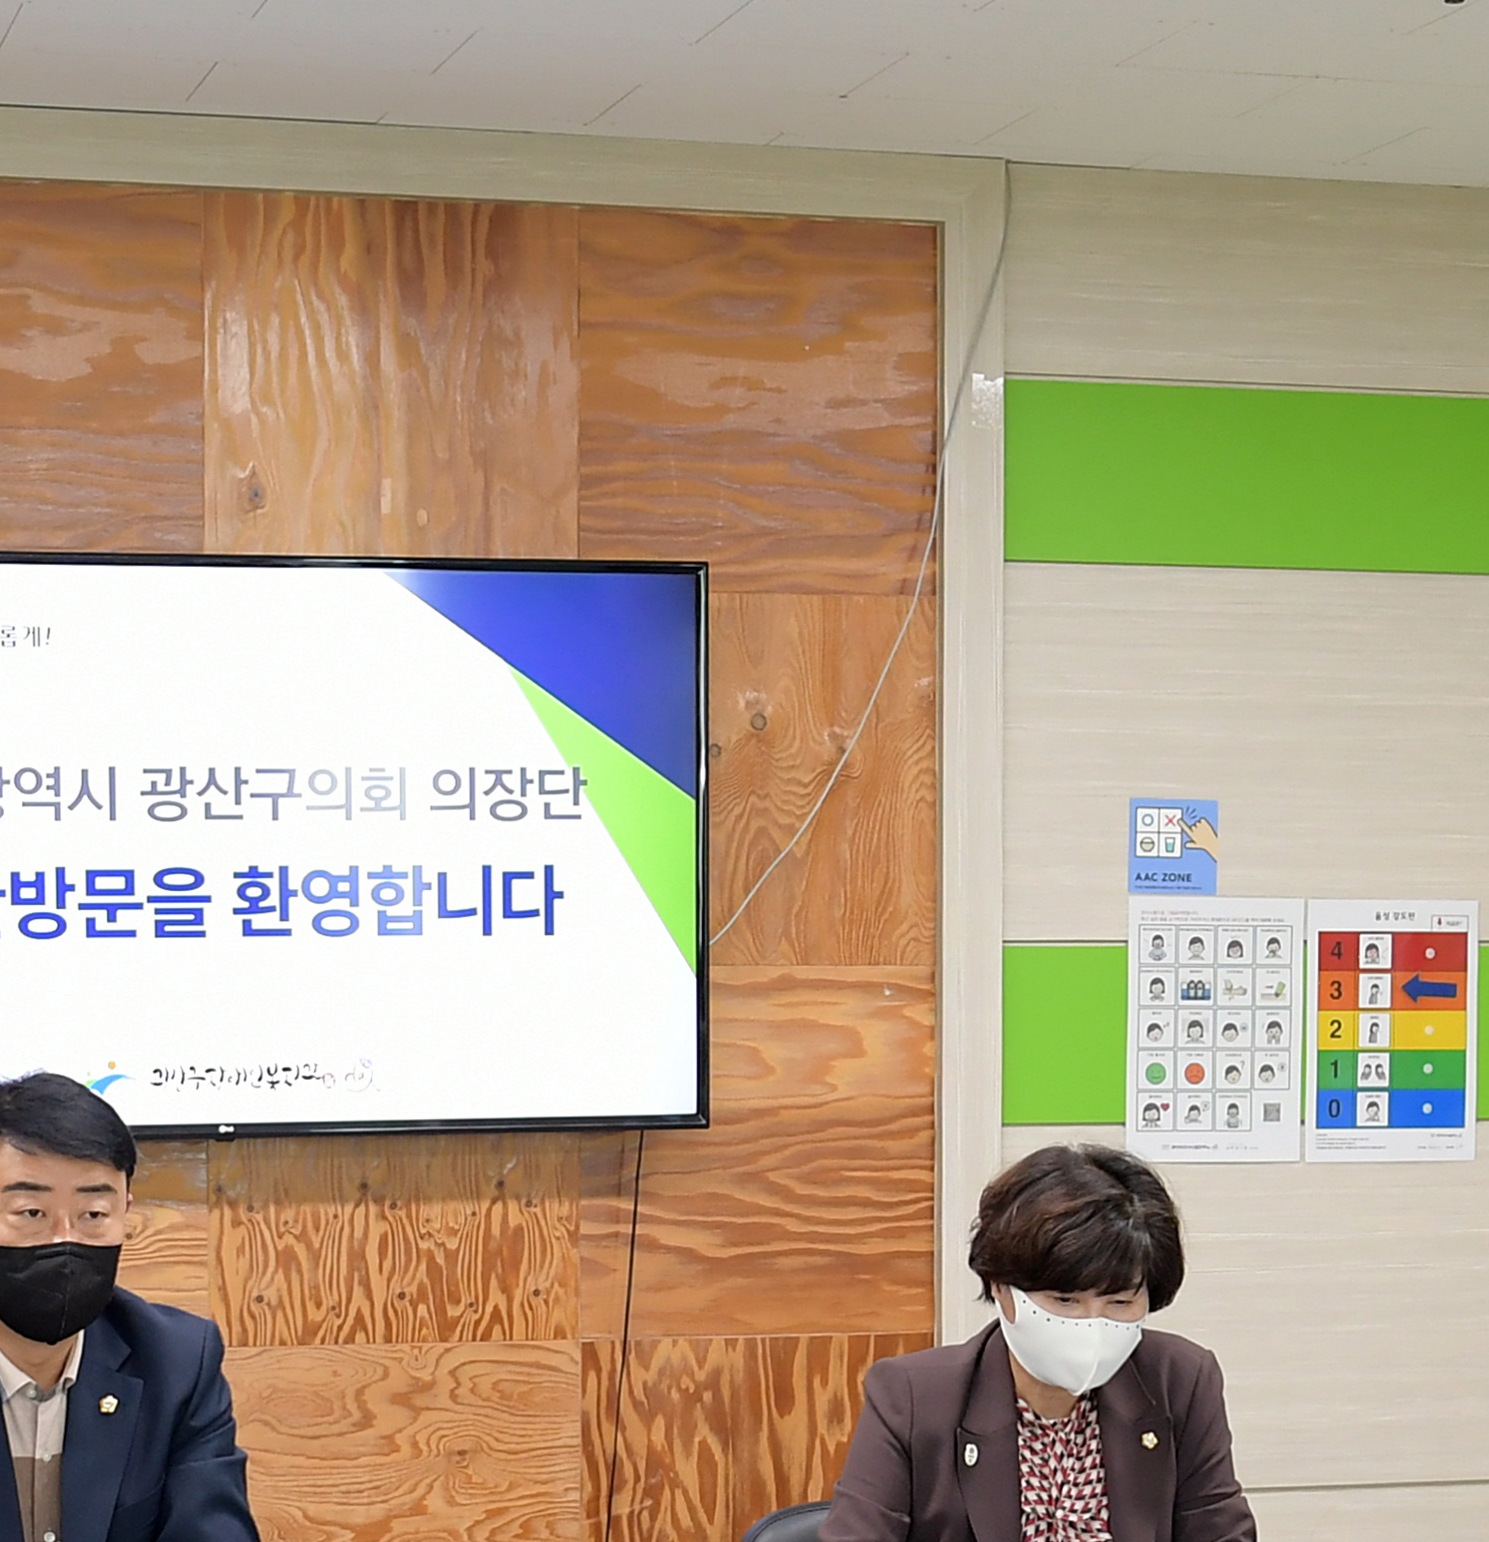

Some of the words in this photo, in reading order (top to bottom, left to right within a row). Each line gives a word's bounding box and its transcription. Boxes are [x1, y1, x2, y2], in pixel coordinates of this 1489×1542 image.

[140, 766, 408, 823] 광산구의회
[429, 766, 588, 823] 의장단
[1134, 872, 1158, 882] AAC
[1161, 873, 1192, 882] ZONE
[232, 864, 565, 938] 환영합니다
[1331, 941, 1343, 960] 4
[1329, 980, 1343, 1000] 3
[1329, 1019, 1343, 1038] 2
[1330, 1059, 1338, 1079] 1
[1328, 1098, 1341, 1118] 0
